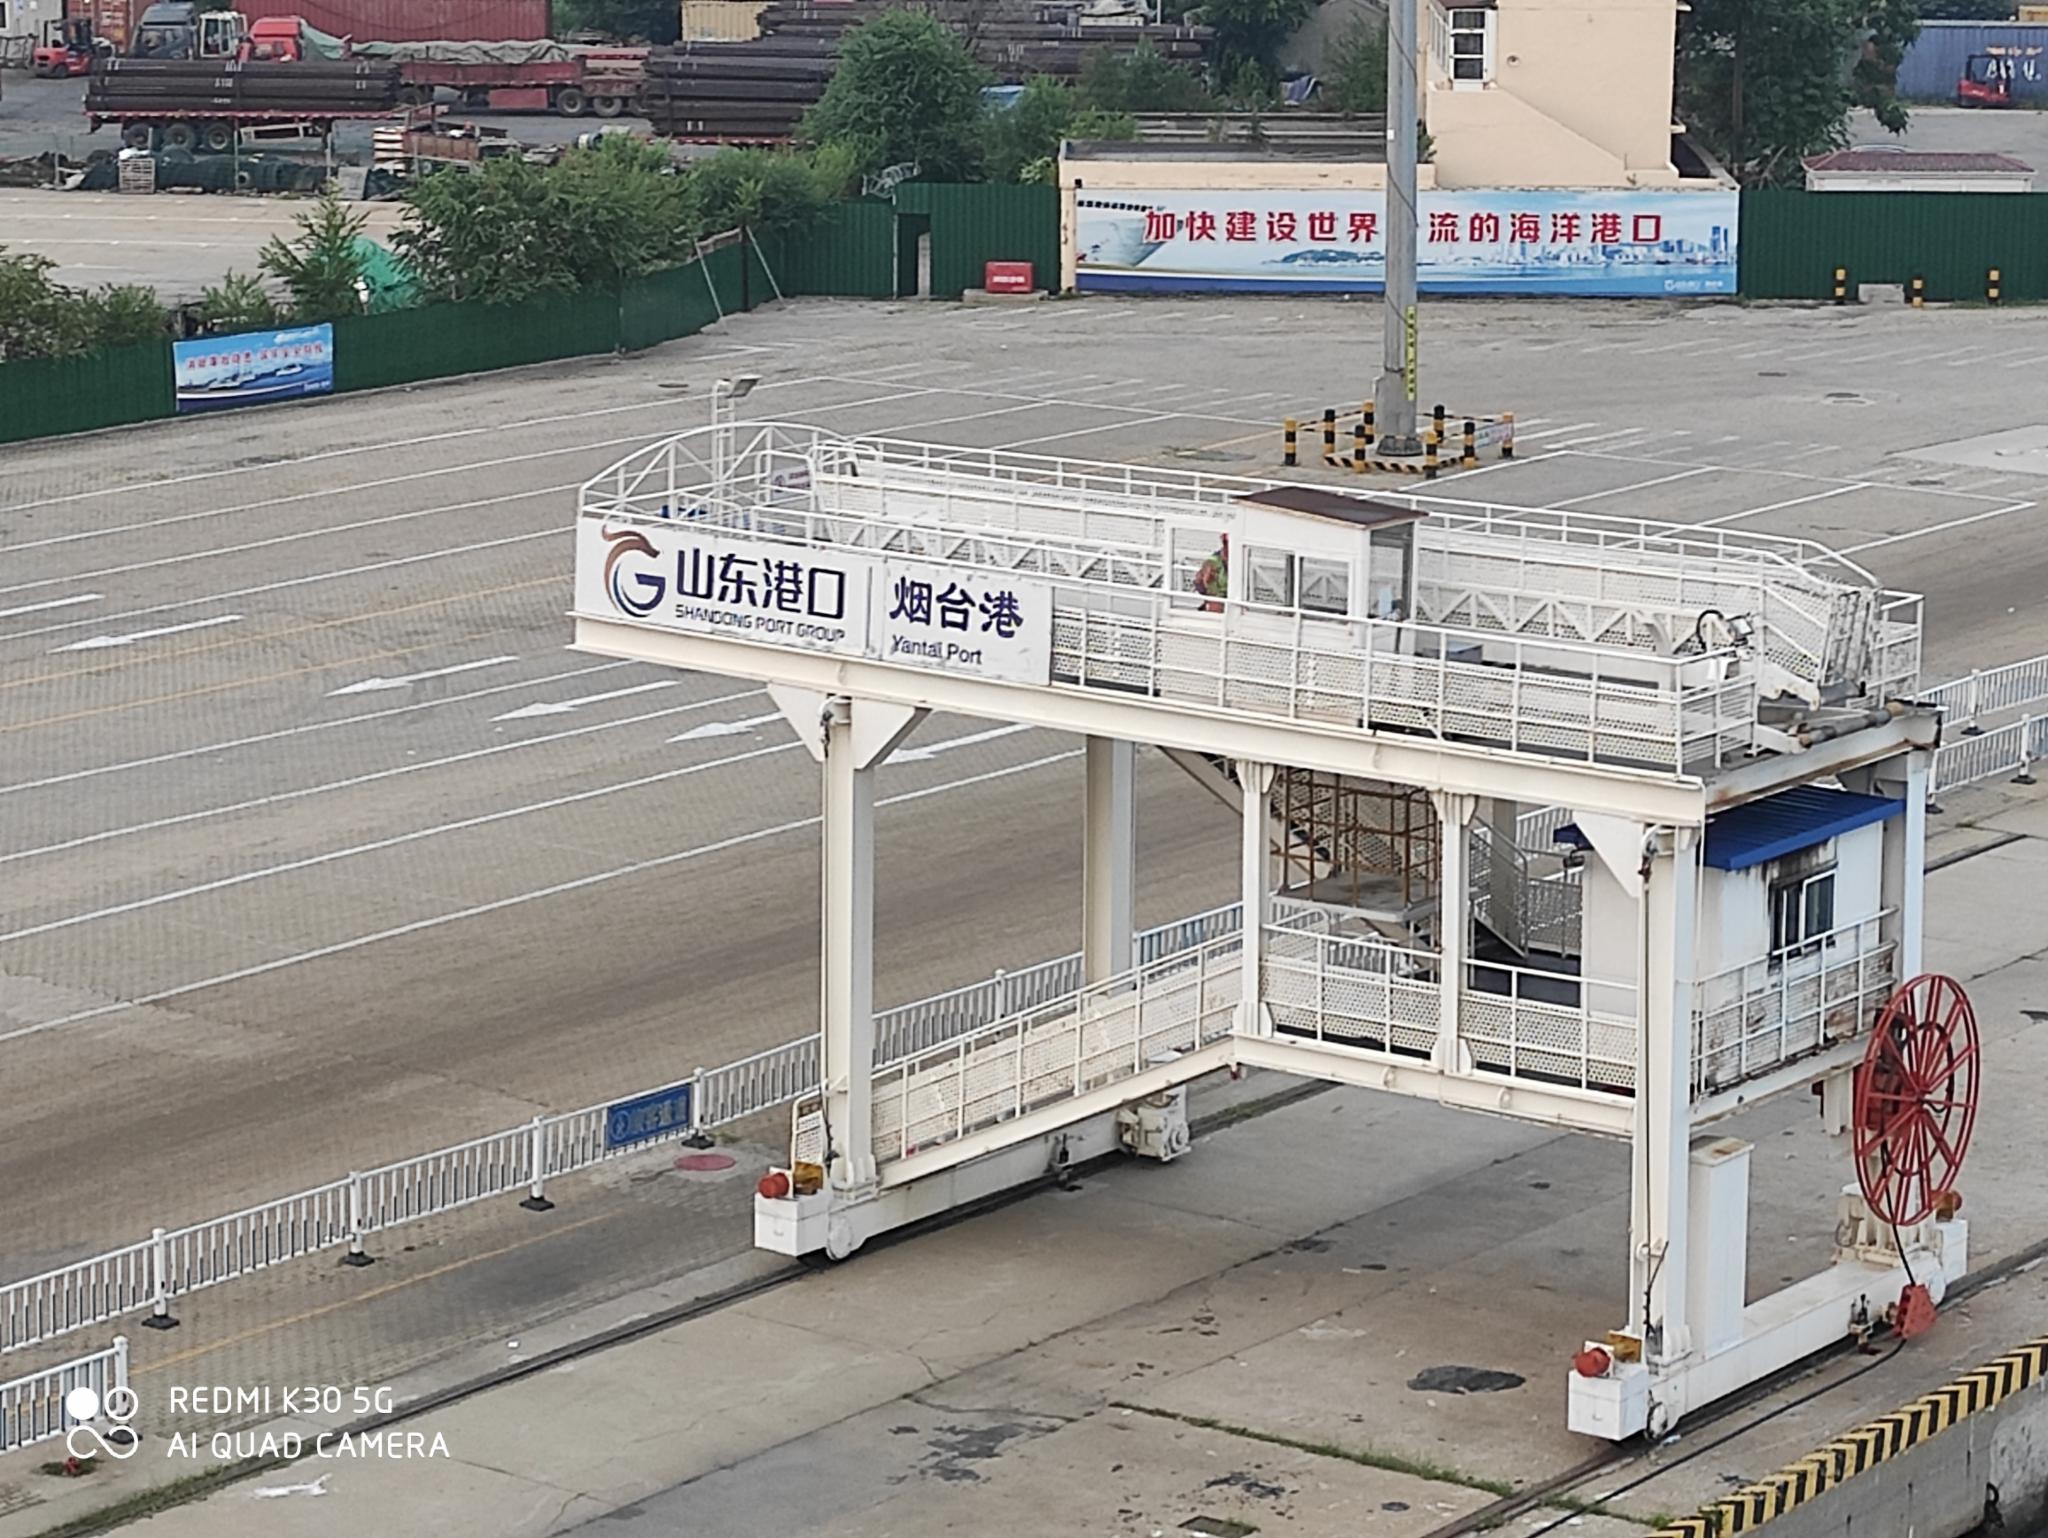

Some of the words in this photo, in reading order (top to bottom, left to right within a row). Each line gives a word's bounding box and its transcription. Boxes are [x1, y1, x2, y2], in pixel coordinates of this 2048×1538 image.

[1145, 210, 1662, 245] 加快建设世界流的海洋港口
[677, 548, 846, 620] 山东港口
[675, 604, 752, 629] SHANDONG
[755, 616, 794, 636] PORT
[796, 622, 846, 643] GROUP
[889, 576, 1024, 638] 烟台港
[891, 634, 943, 659] Yantai
[946, 643, 983, 665] Port
